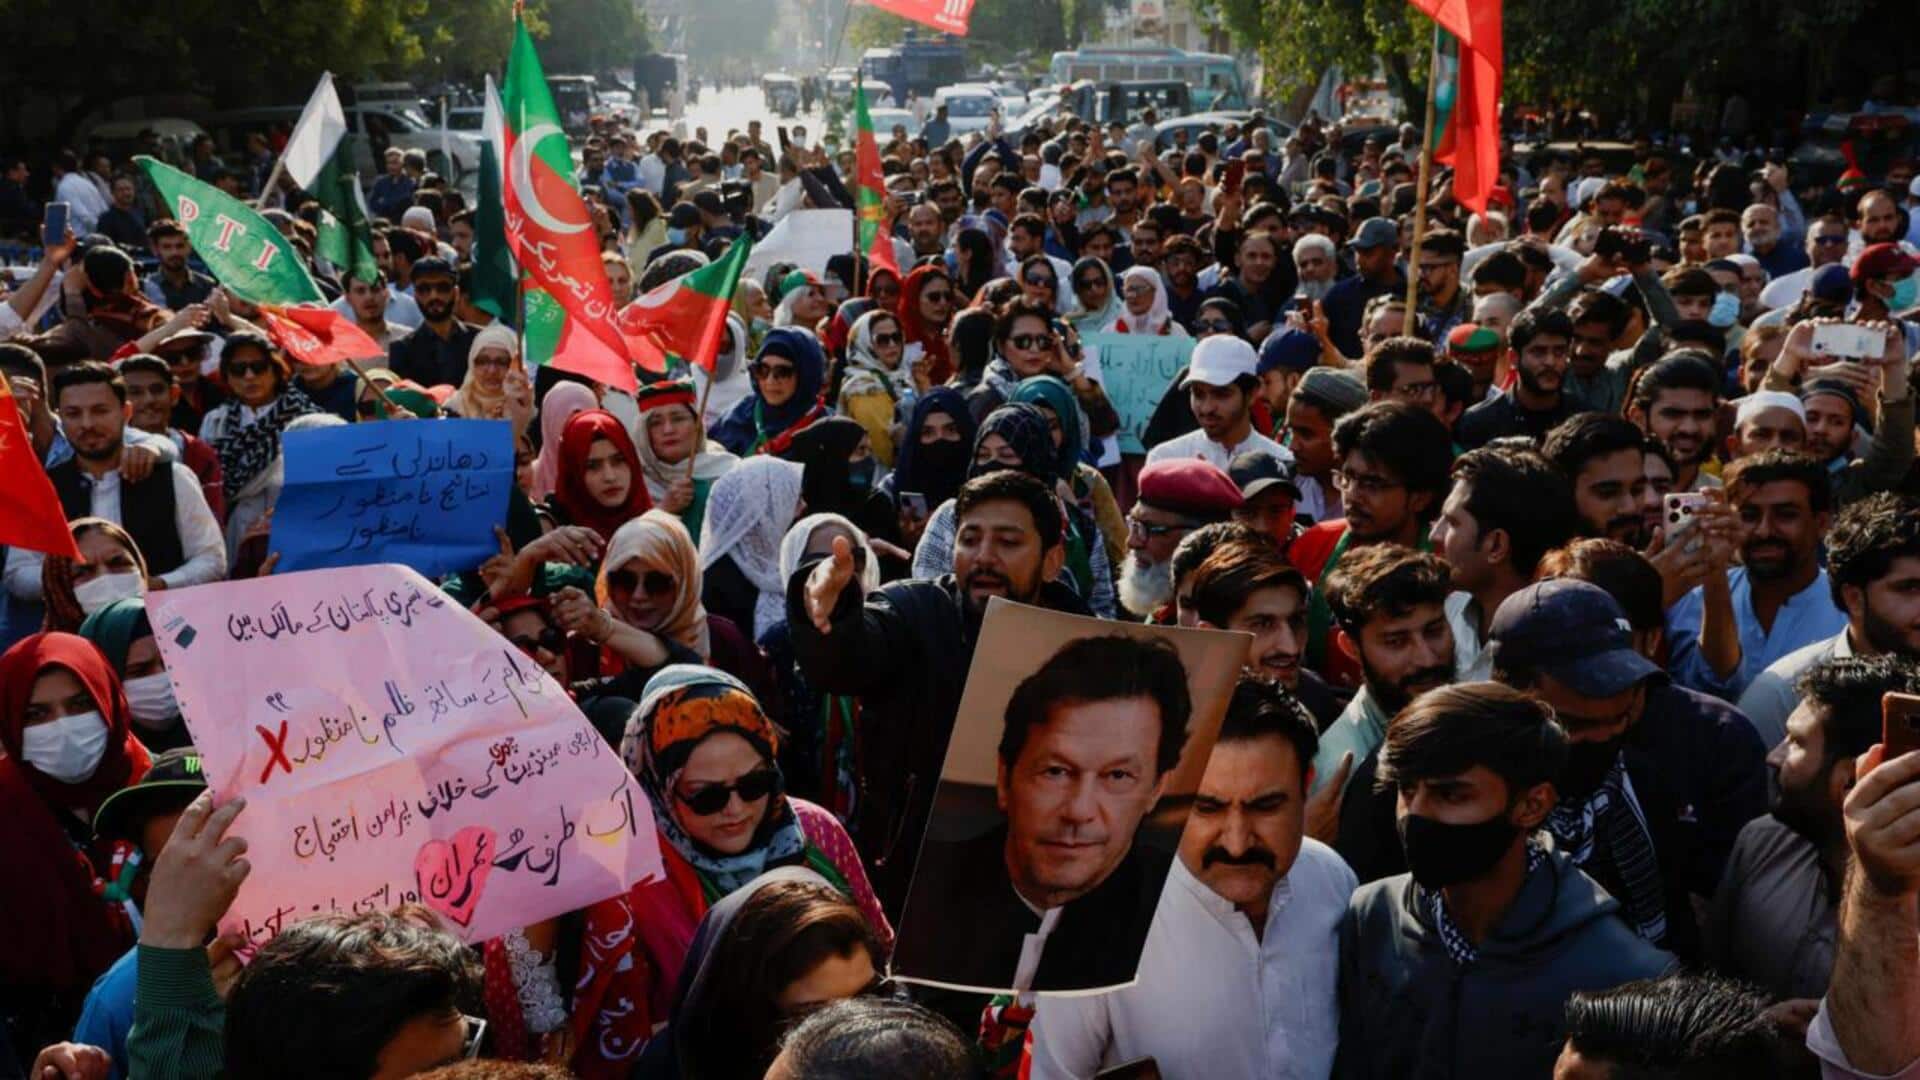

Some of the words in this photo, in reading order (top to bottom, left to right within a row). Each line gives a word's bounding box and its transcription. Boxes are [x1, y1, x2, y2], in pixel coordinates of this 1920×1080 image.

[1126, 107, 1181, 121] POICE
[178, 194, 279, 271] PTI
[335, 443, 388, 476] کے
[391, 436, 488, 480] دھاندلی
[306, 601, 331, 632] کے
[384, 680, 415, 754] ظلم
[418, 776, 467, 818] خلاف
[431, 833, 487, 908] عمران
